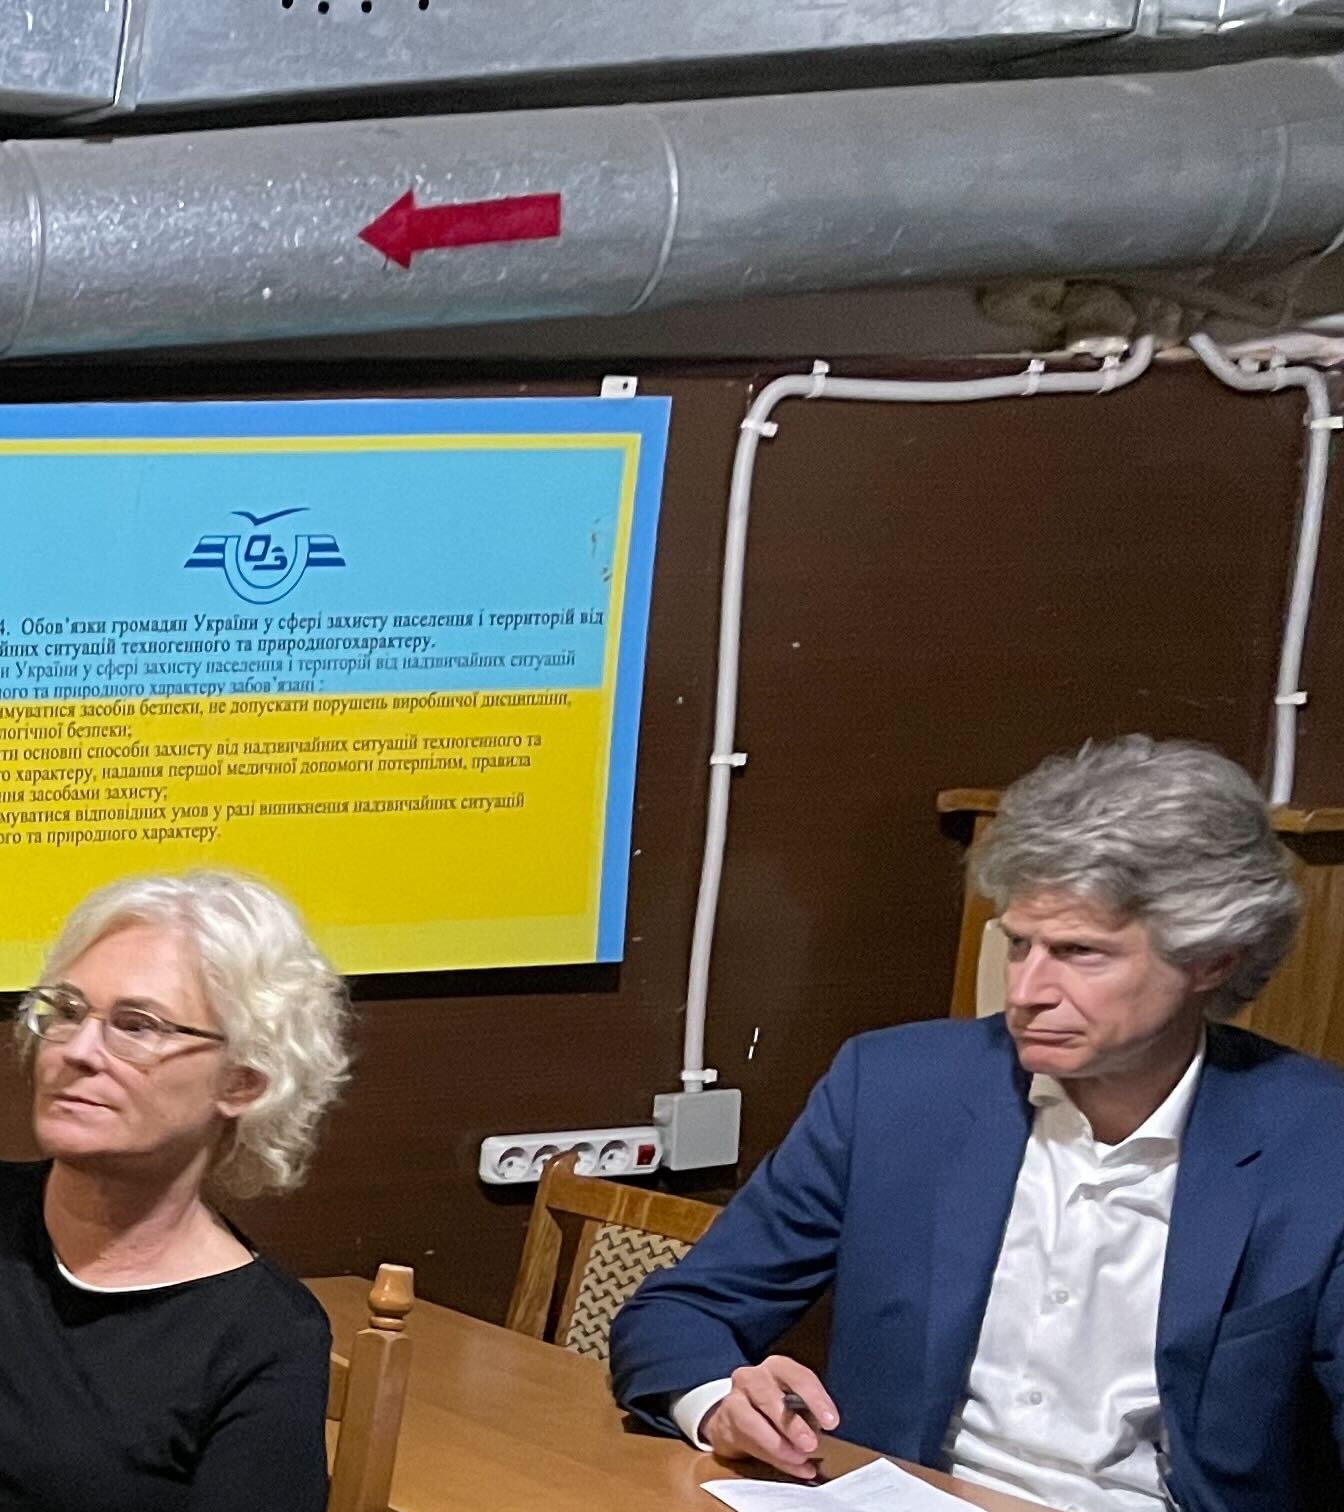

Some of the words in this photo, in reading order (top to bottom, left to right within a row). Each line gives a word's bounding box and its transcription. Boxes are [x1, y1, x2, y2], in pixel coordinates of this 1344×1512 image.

[111, 617, 188, 638] громадян
[194, 613, 258, 635] України
[263, 618, 273, 634] у
[278, 612, 322, 637] сфері
[327, 615, 388, 634] захисту
[393, 612, 473, 629] населення
[580, 608, 604, 627] від
[44, 637, 116, 659] ситуацій
[121, 638, 230, 656] техногенного
[235, 640, 252, 652] та
[15, 660, 78, 681] України
[83, 665, 92, 681] у
[96, 657, 139, 682] сфері
[144, 660, 202, 678] захисту
[206, 656, 283, 674] населення
[298, 652, 371, 677] територій
[376, 651, 398, 670] від
[402, 649, 506, 671] надзвичайних
[510, 649, 576, 671] ситуацій
[33, 686, 48, 699] та
[52, 680, 145, 702] природного
[149, 678, 225, 697] характеру
[79, 702, 135, 719] засобів
[139, 700, 203, 717] безпеки,
[208, 700, 226, 714] не
[230, 698, 308, 717] допускати
[313, 697, 388, 716] порушень
[392, 691, 477, 713] виробничої
[67, 722, 132, 739] безпеки;
[23, 742, 82, 761] основні
[87, 741, 149, 759] способи
[154, 742, 211, 760] захисту
[216, 738, 238, 756] від
[243, 736, 348, 756] надзвичайних
[352, 733, 418, 755] ситуацій
[422, 734, 522, 751] техногенного
[526, 734, 541, 747] та
[15, 765, 97, 785] характеру,
[102, 763, 163, 779] надання
[168, 760, 222, 781] першої
[227, 756, 296, 777] медичної
[300, 757, 373, 775] допомоги
[472, 753, 531, 773] правила
[29, 784, 100, 803] засобами
[104, 783, 169, 802] захисту;
[75, 802, 167, 824] відповідних
[171, 804, 208, 823] умов
[213, 805, 223, 822] у
[226, 800, 255, 820] разі
[259, 800, 349, 817] виникнення
[353, 794, 457, 814] надзвичайних
[461, 792, 525, 813] ситуацій
[26, 831, 42, 844] та
[47, 827, 137, 847] природного
[142, 824, 221, 843] характеру.
